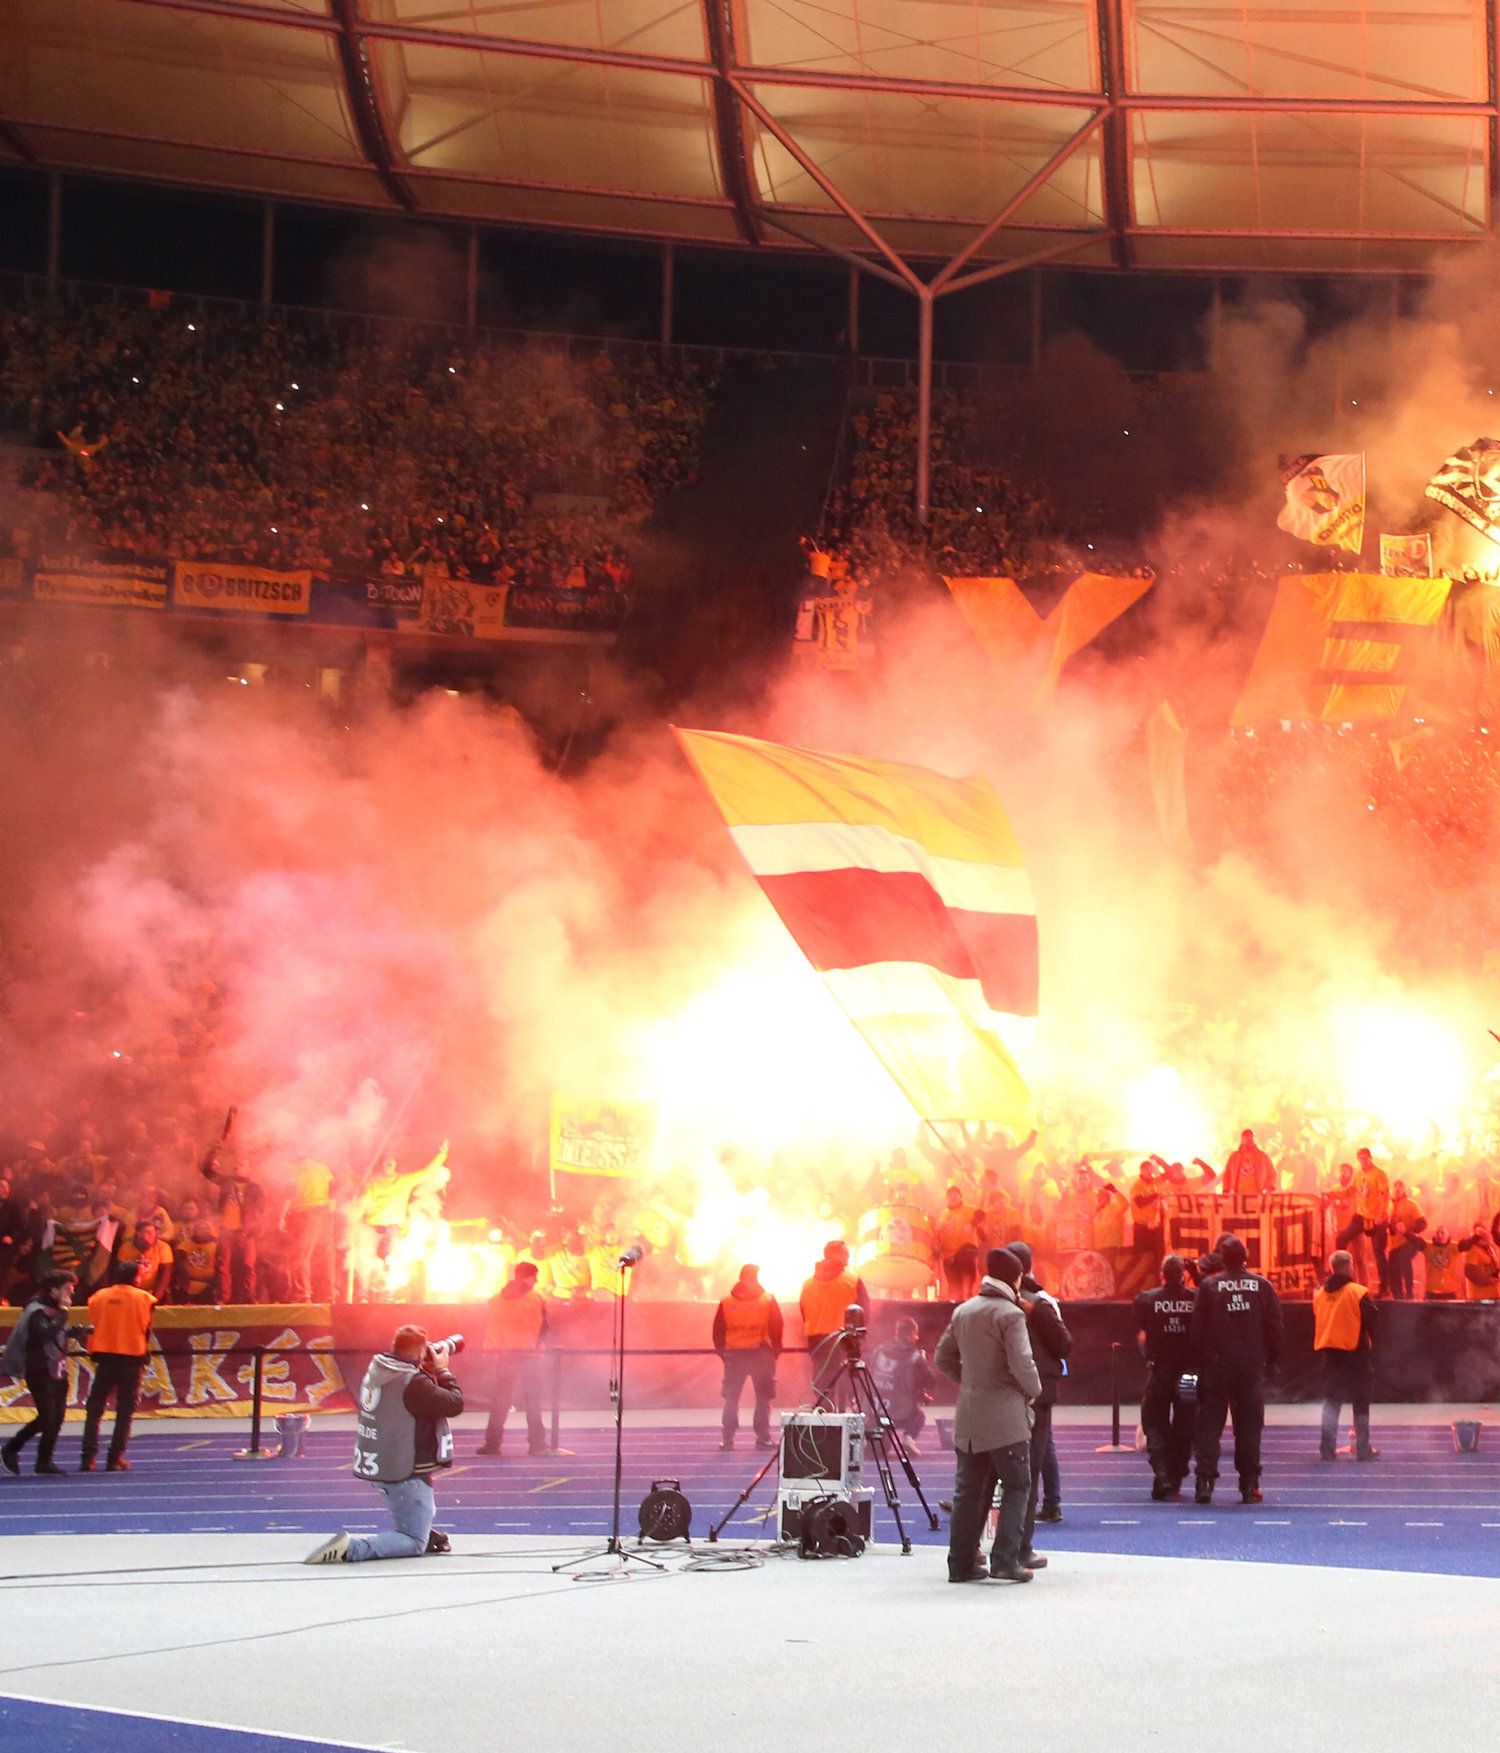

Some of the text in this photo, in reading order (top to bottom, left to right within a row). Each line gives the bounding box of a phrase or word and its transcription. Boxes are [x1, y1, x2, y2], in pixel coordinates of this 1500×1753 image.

[225, 577, 302, 601] BRITZSCH
[1178, 1193, 1303, 1215] OFFICIAL
[1217, 1279, 1259, 1292] POLIZEI
[1257, 1268, 1316, 1291] ANS
[1232, 1294, 1243, 1303] BE
[353, 1445, 380, 1476] 23
